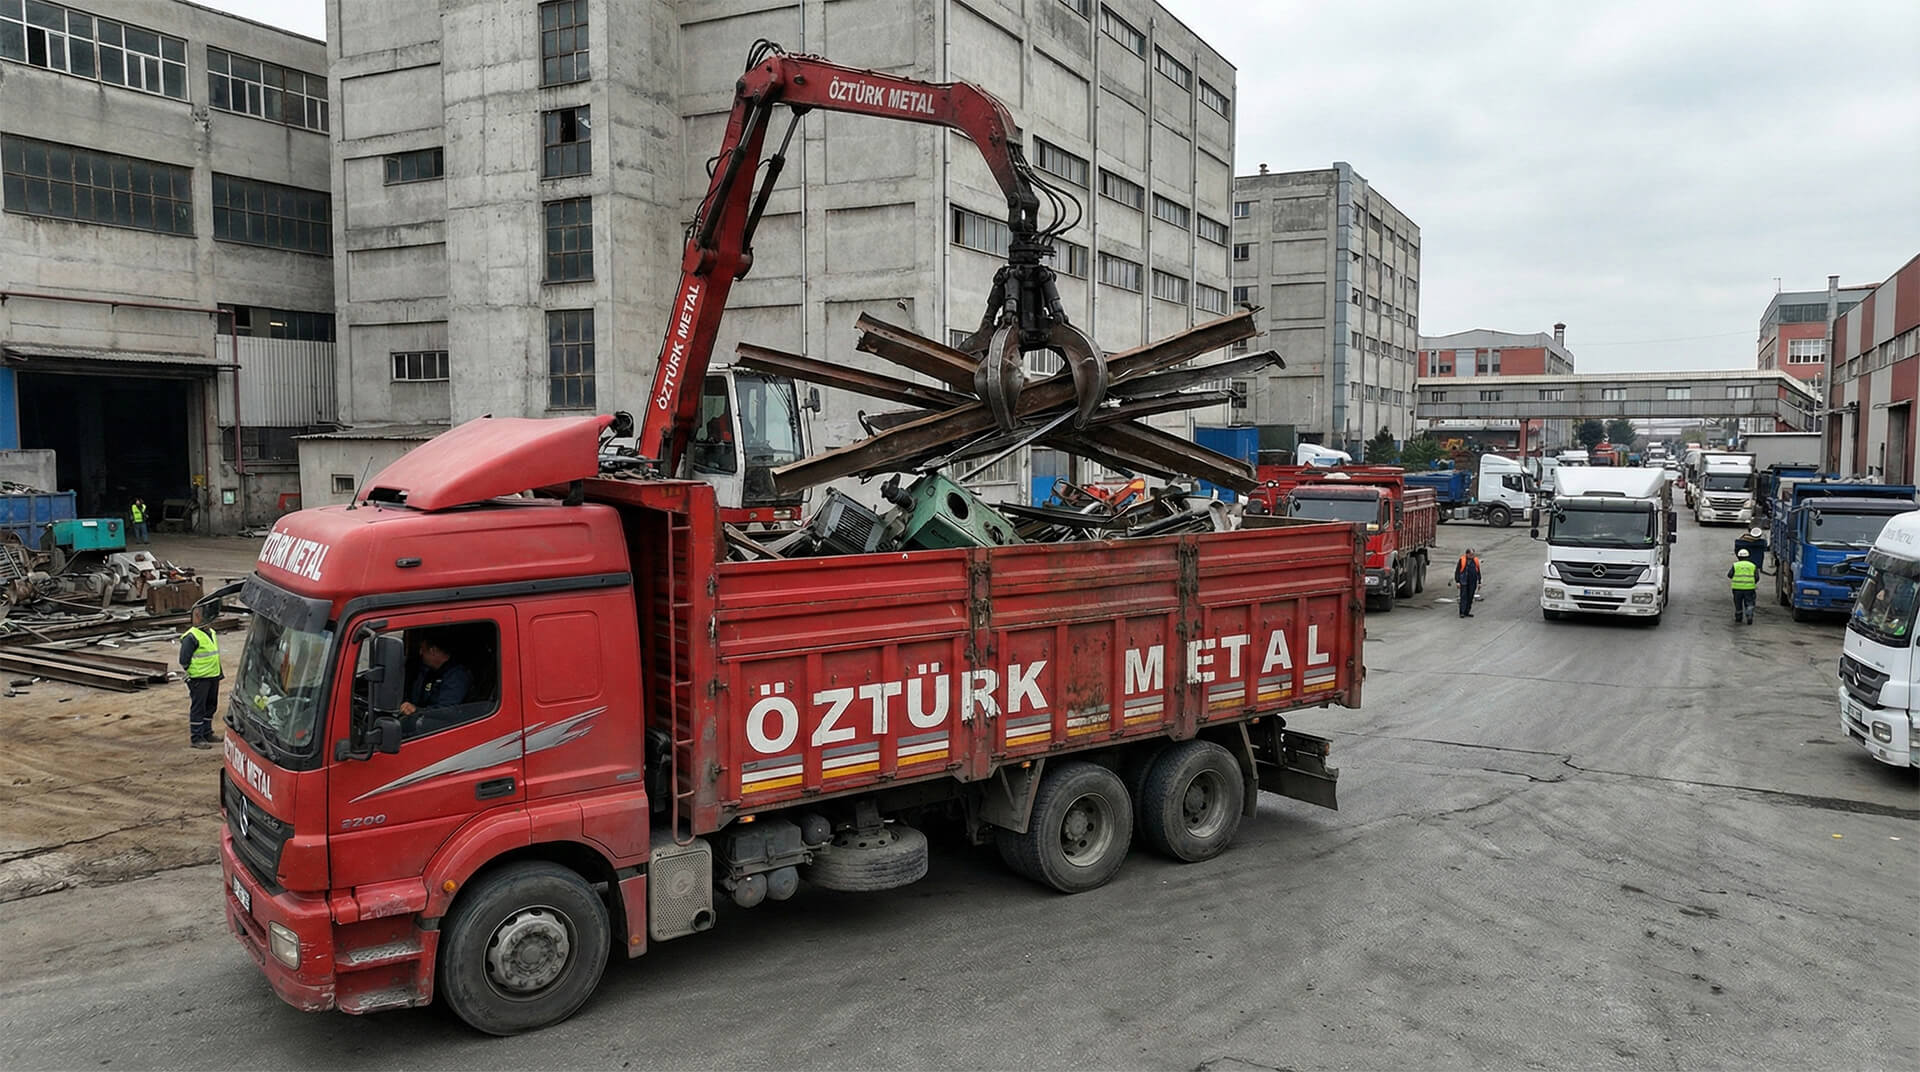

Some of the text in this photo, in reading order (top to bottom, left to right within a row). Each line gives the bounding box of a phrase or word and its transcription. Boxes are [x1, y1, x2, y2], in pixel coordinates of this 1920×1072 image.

[828, 76, 935, 114] ÖZTÜRK METAL
[656, 285, 700, 410] ÖZTÜRK METAL
[285, 537, 330, 582] METAL
[746, 624, 1330, 754] ÖZTÜRK METAL
[247, 758, 273, 802] METAL
